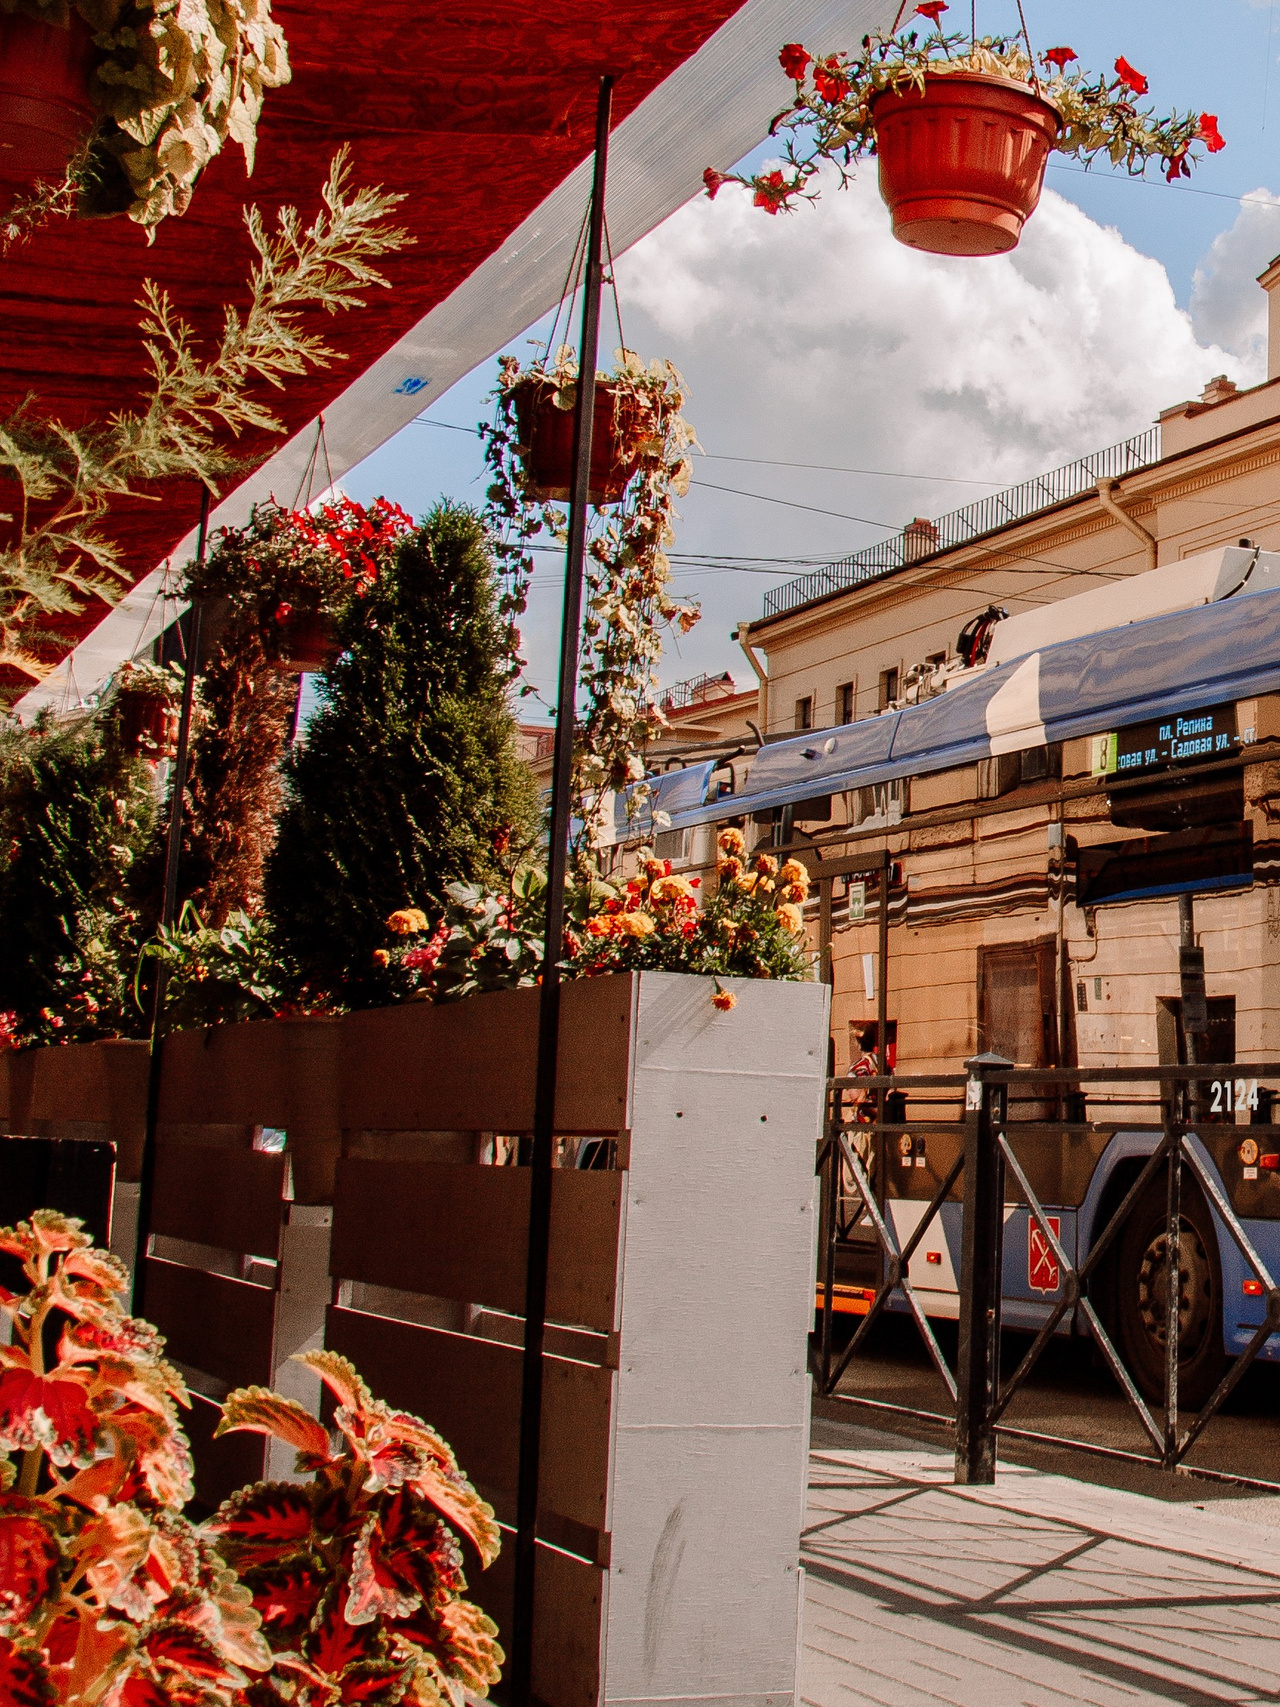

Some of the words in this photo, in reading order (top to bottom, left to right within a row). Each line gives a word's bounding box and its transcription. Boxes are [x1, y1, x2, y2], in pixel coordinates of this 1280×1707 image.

[1159, 725, 1174, 742] пл.
[1176, 716, 1213, 736] Репина
[1100, 737, 1108, 770] 8
[1145, 748, 1159, 766] ул.
[1171, 736, 1213, 759] Садовая
[1215, 733, 1230, 752] ул.
[1210, 1078, 1259, 1113] 2124
